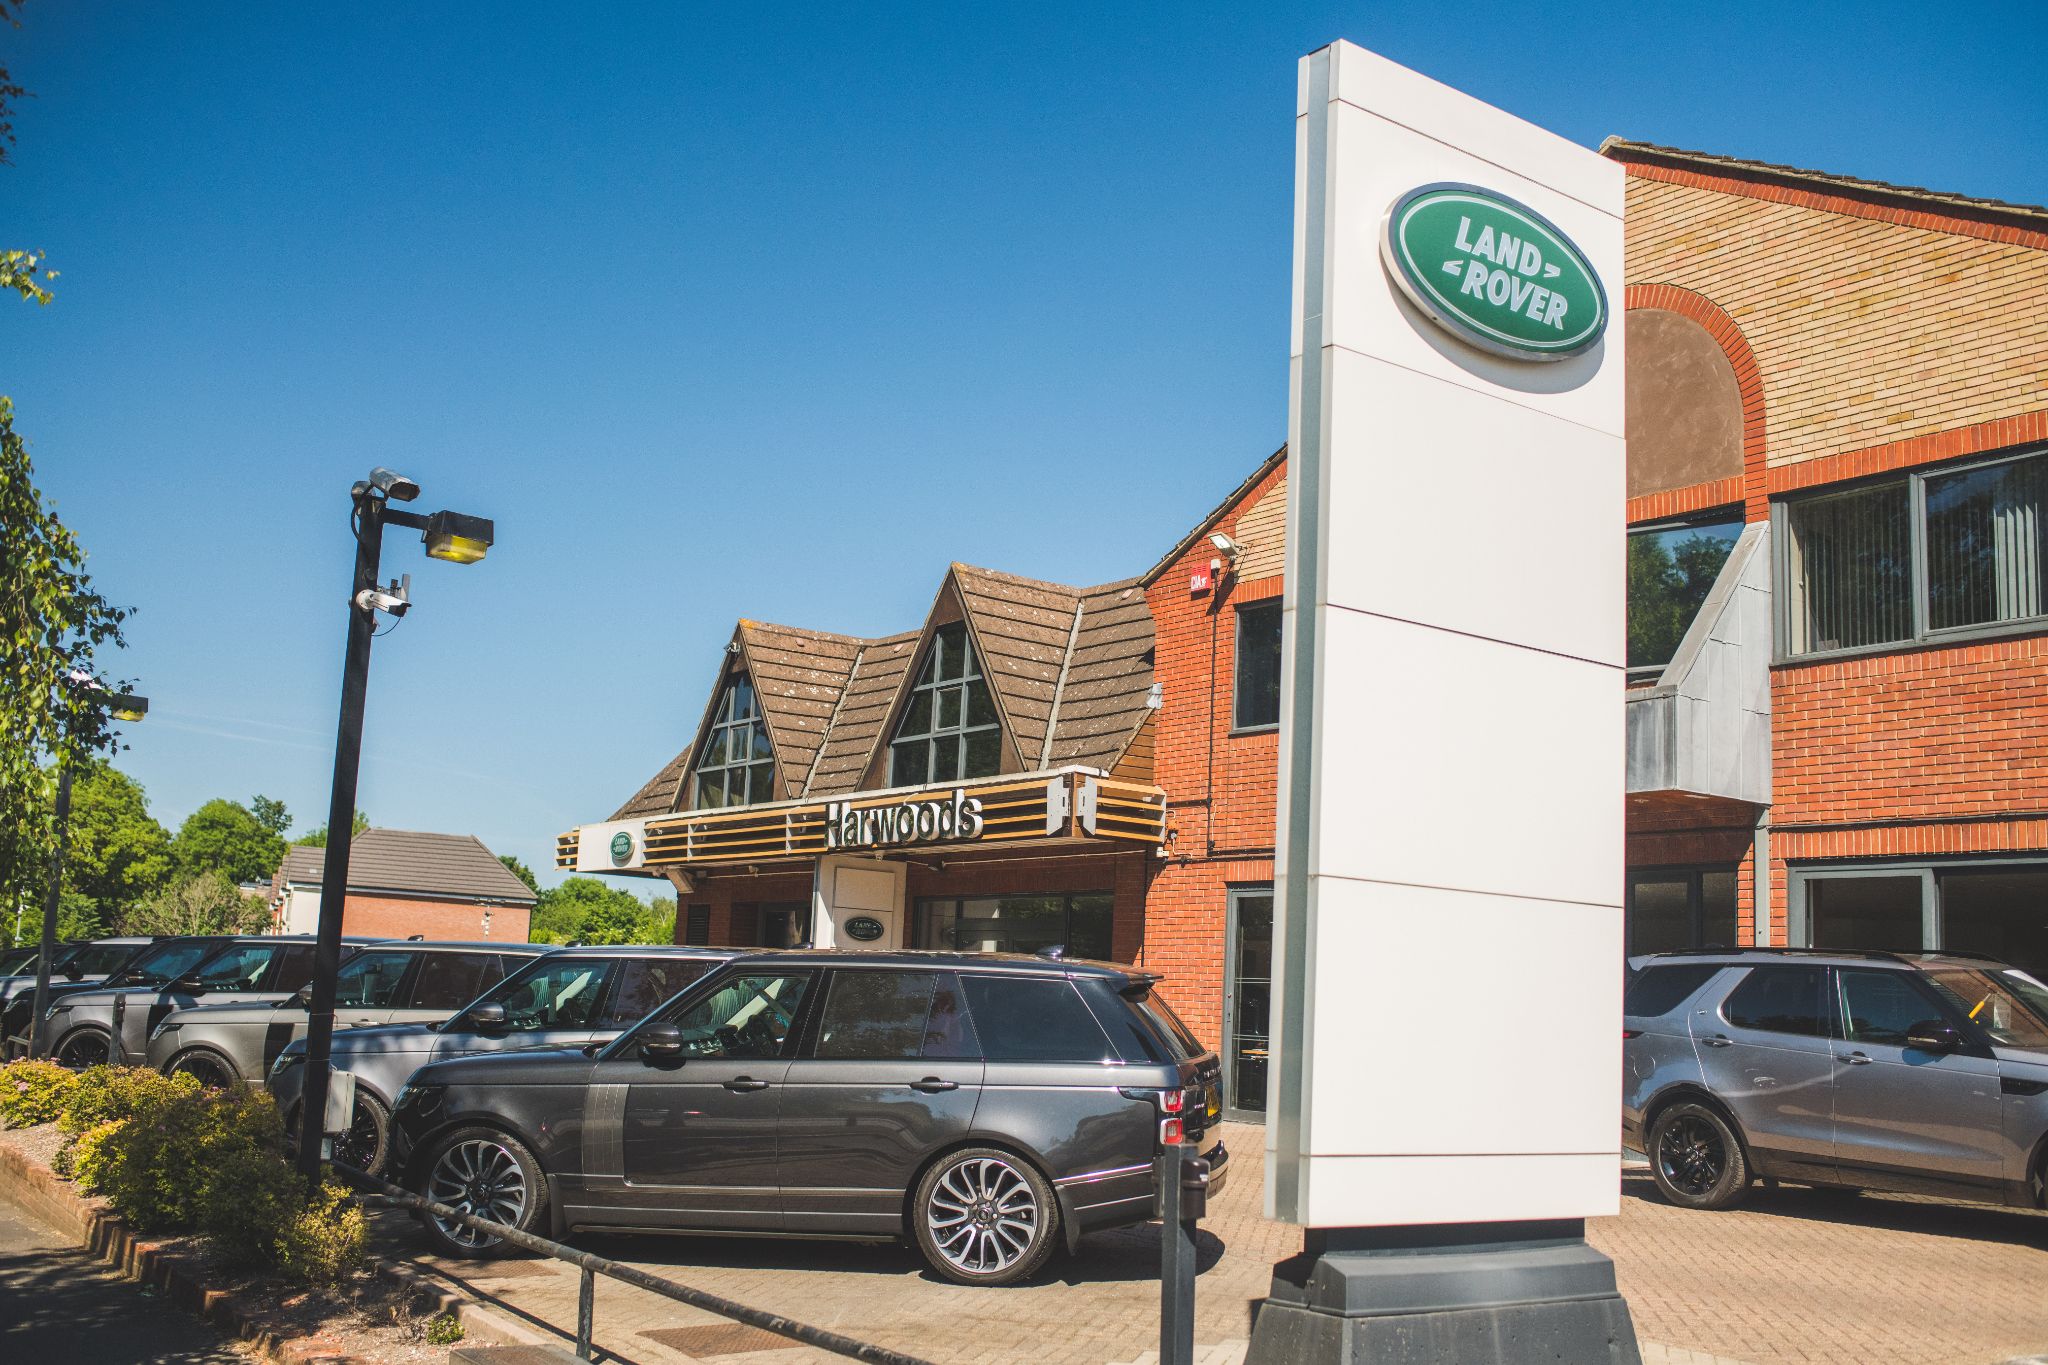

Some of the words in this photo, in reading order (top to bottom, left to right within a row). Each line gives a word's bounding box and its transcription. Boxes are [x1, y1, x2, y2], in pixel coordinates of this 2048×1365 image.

[1454, 215, 1542, 277] LAND
[1460, 260, 1568, 330] ROVER
[824, 788, 983, 849] Harwoods
